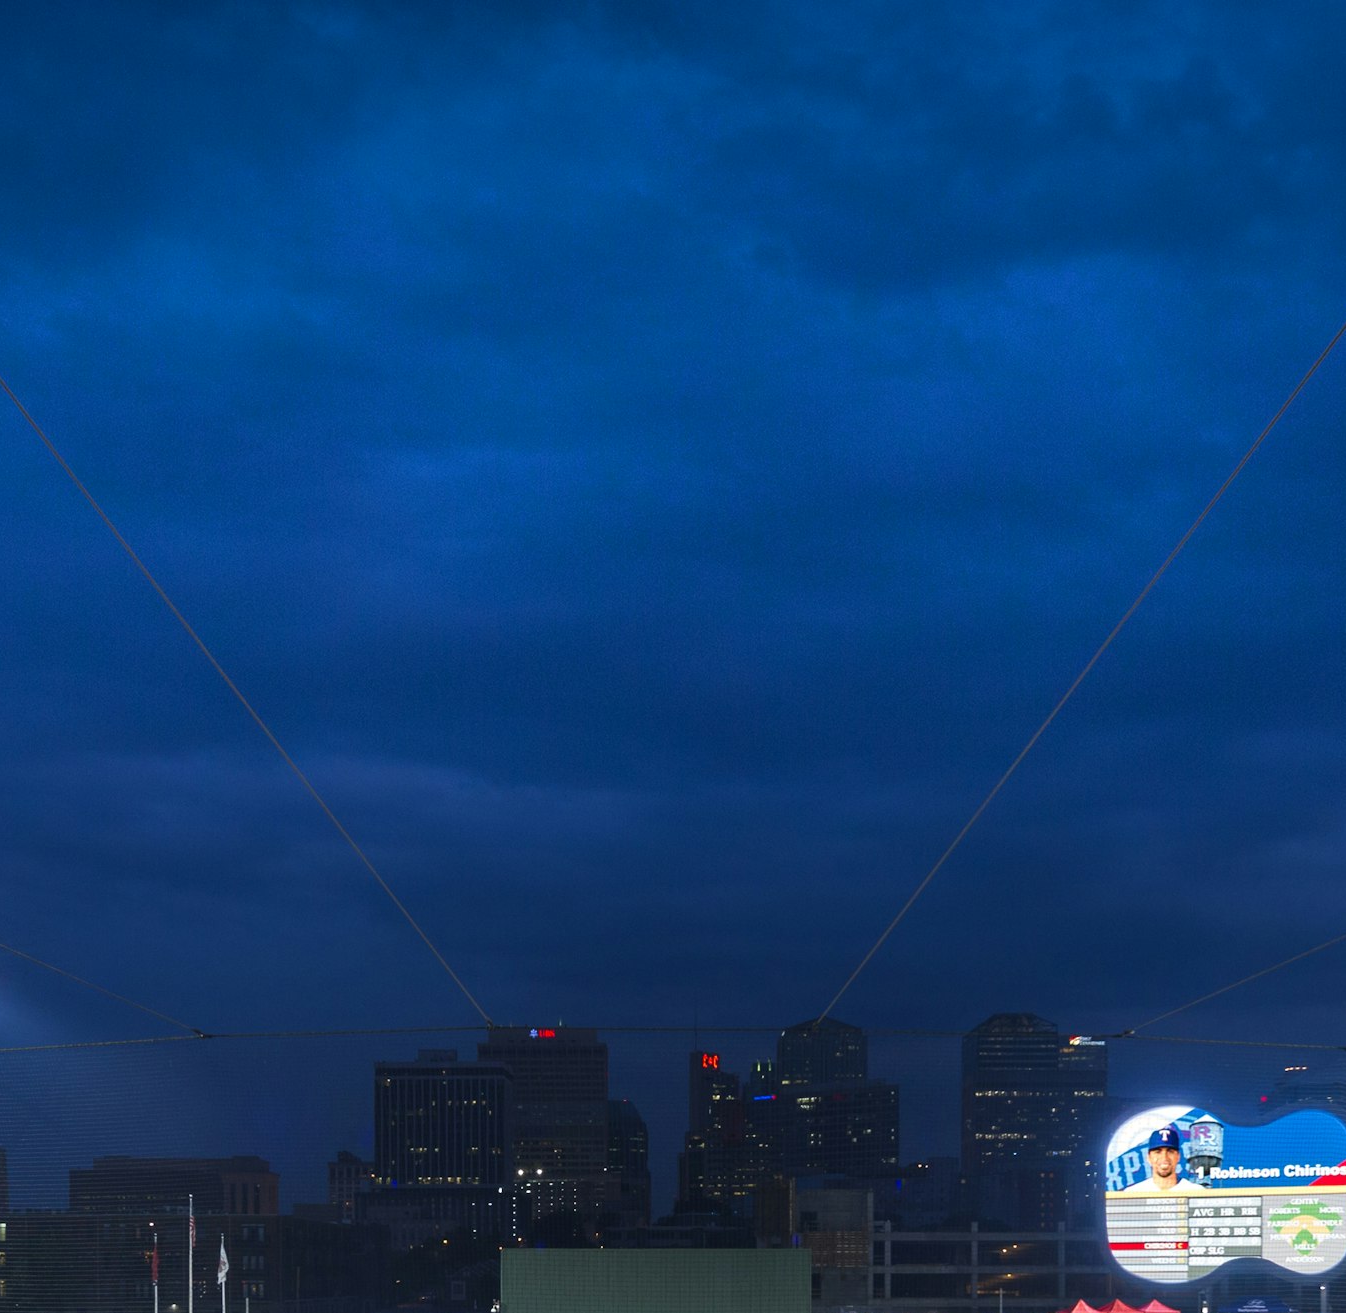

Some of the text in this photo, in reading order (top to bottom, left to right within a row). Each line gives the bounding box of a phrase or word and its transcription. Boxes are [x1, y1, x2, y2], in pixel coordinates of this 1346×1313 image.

[1195, 1168, 1204, 1180] 1
[1210, 1166, 1280, 1179] Robinson
[1193, 1208, 1214, 1217] AVG
[1220, 1208, 1235, 1216] HR
[1241, 1207, 1258, 1216] RBI
[1190, 1228, 1199, 1236] H
[1203, 1228, 1216, 1236] 2B
[1218, 1228, 1230, 1236] 3B
[1248, 1227, 1261, 1236] SB
[1207, 1247, 1225, 1255] SLG
